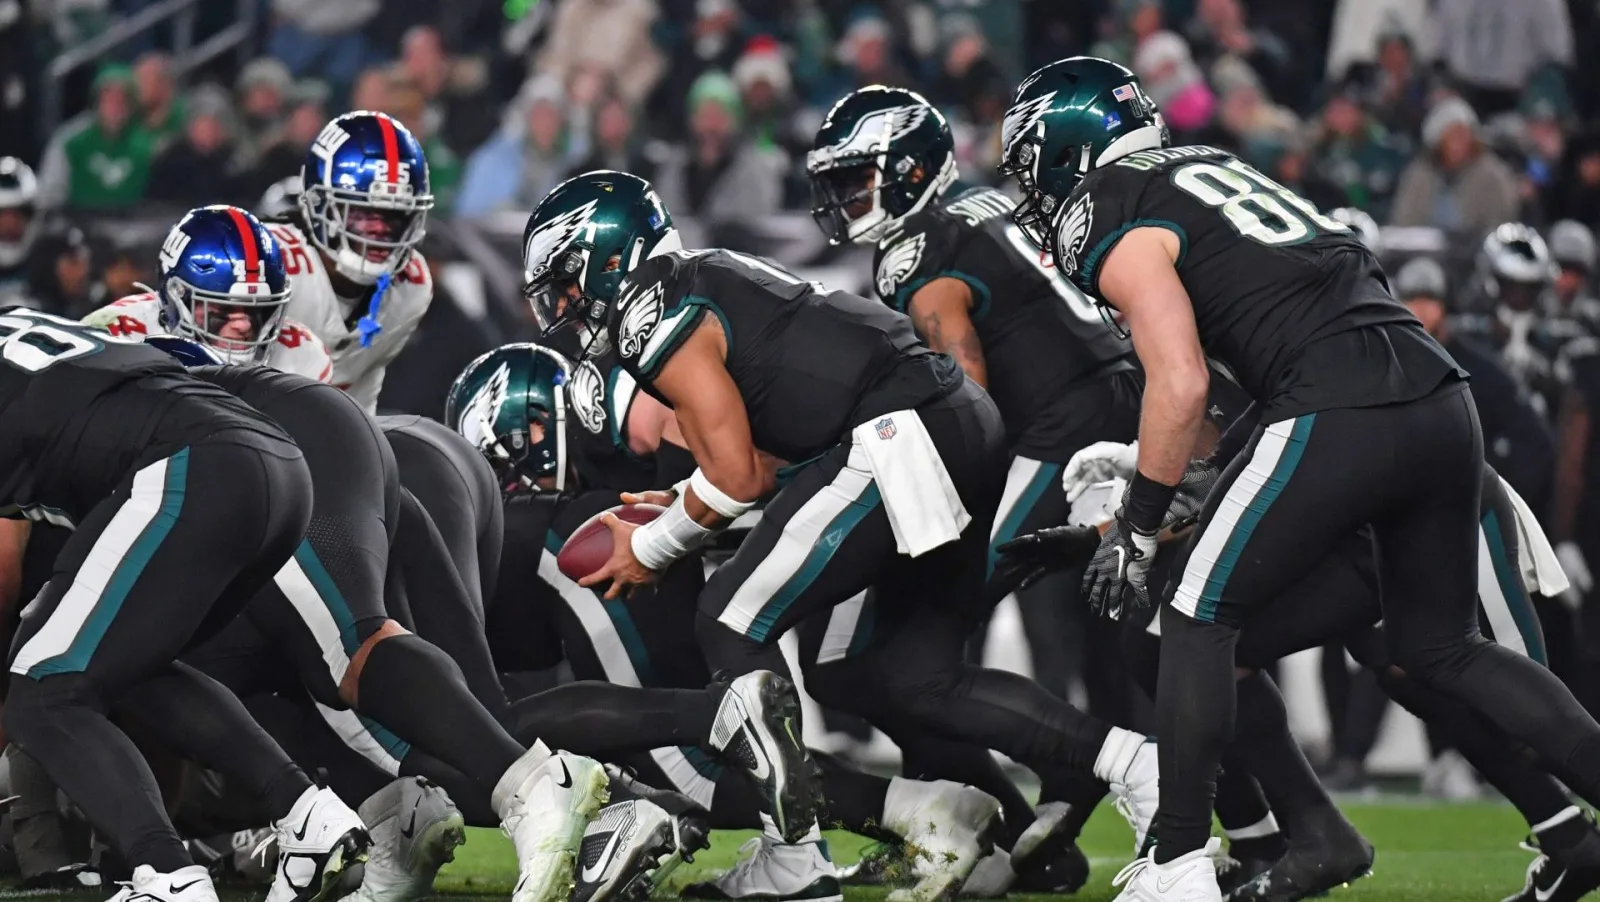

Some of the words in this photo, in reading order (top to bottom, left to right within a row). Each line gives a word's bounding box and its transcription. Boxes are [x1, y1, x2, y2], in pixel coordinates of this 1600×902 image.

[1115, 145, 1228, 171] GOEDE
[374, 159, 411, 185] 25
[233, 259, 267, 282] 41
